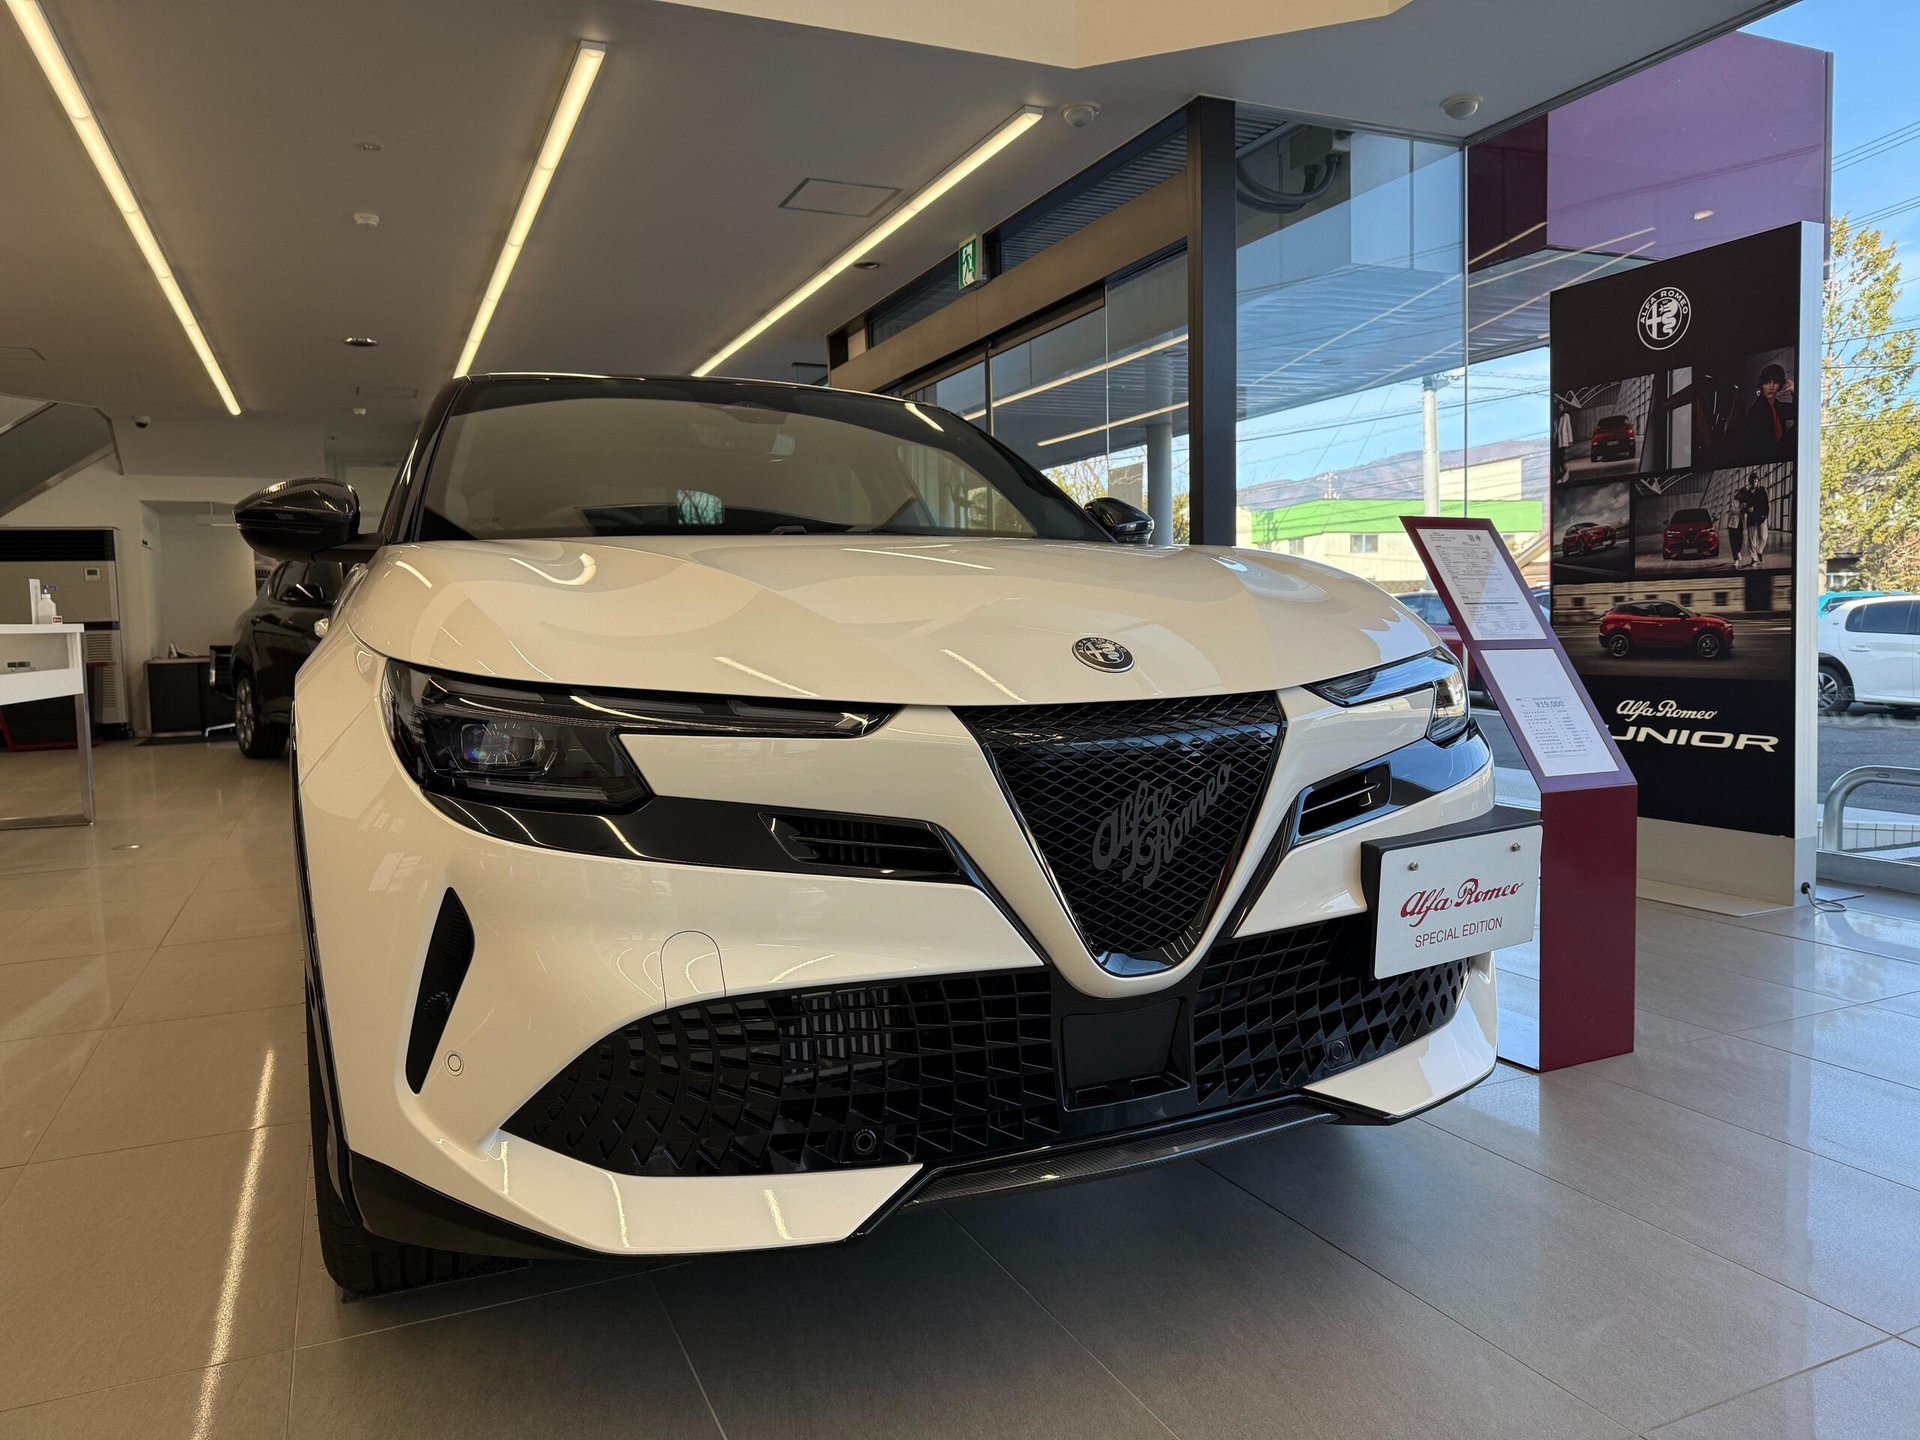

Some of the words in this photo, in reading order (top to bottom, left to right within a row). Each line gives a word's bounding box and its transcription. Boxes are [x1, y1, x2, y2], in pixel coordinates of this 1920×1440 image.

[1640, 297, 1657, 324] ALFA
[1660, 290, 1689, 315] ROMEO
[1616, 699, 1656, 722] Alfa
[1655, 699, 1718, 720] Romeo
[1605, 724, 1780, 753] UNIOR
[1092, 779, 1173, 883] Alfa
[1136, 763, 1232, 890] Romeo
[1400, 887, 1453, 928] Alfa
[1454, 877, 1525, 908] Romeo
[1414, 926, 1460, 949] SPECIAL
[1462, 916, 1504, 938] EDITION
